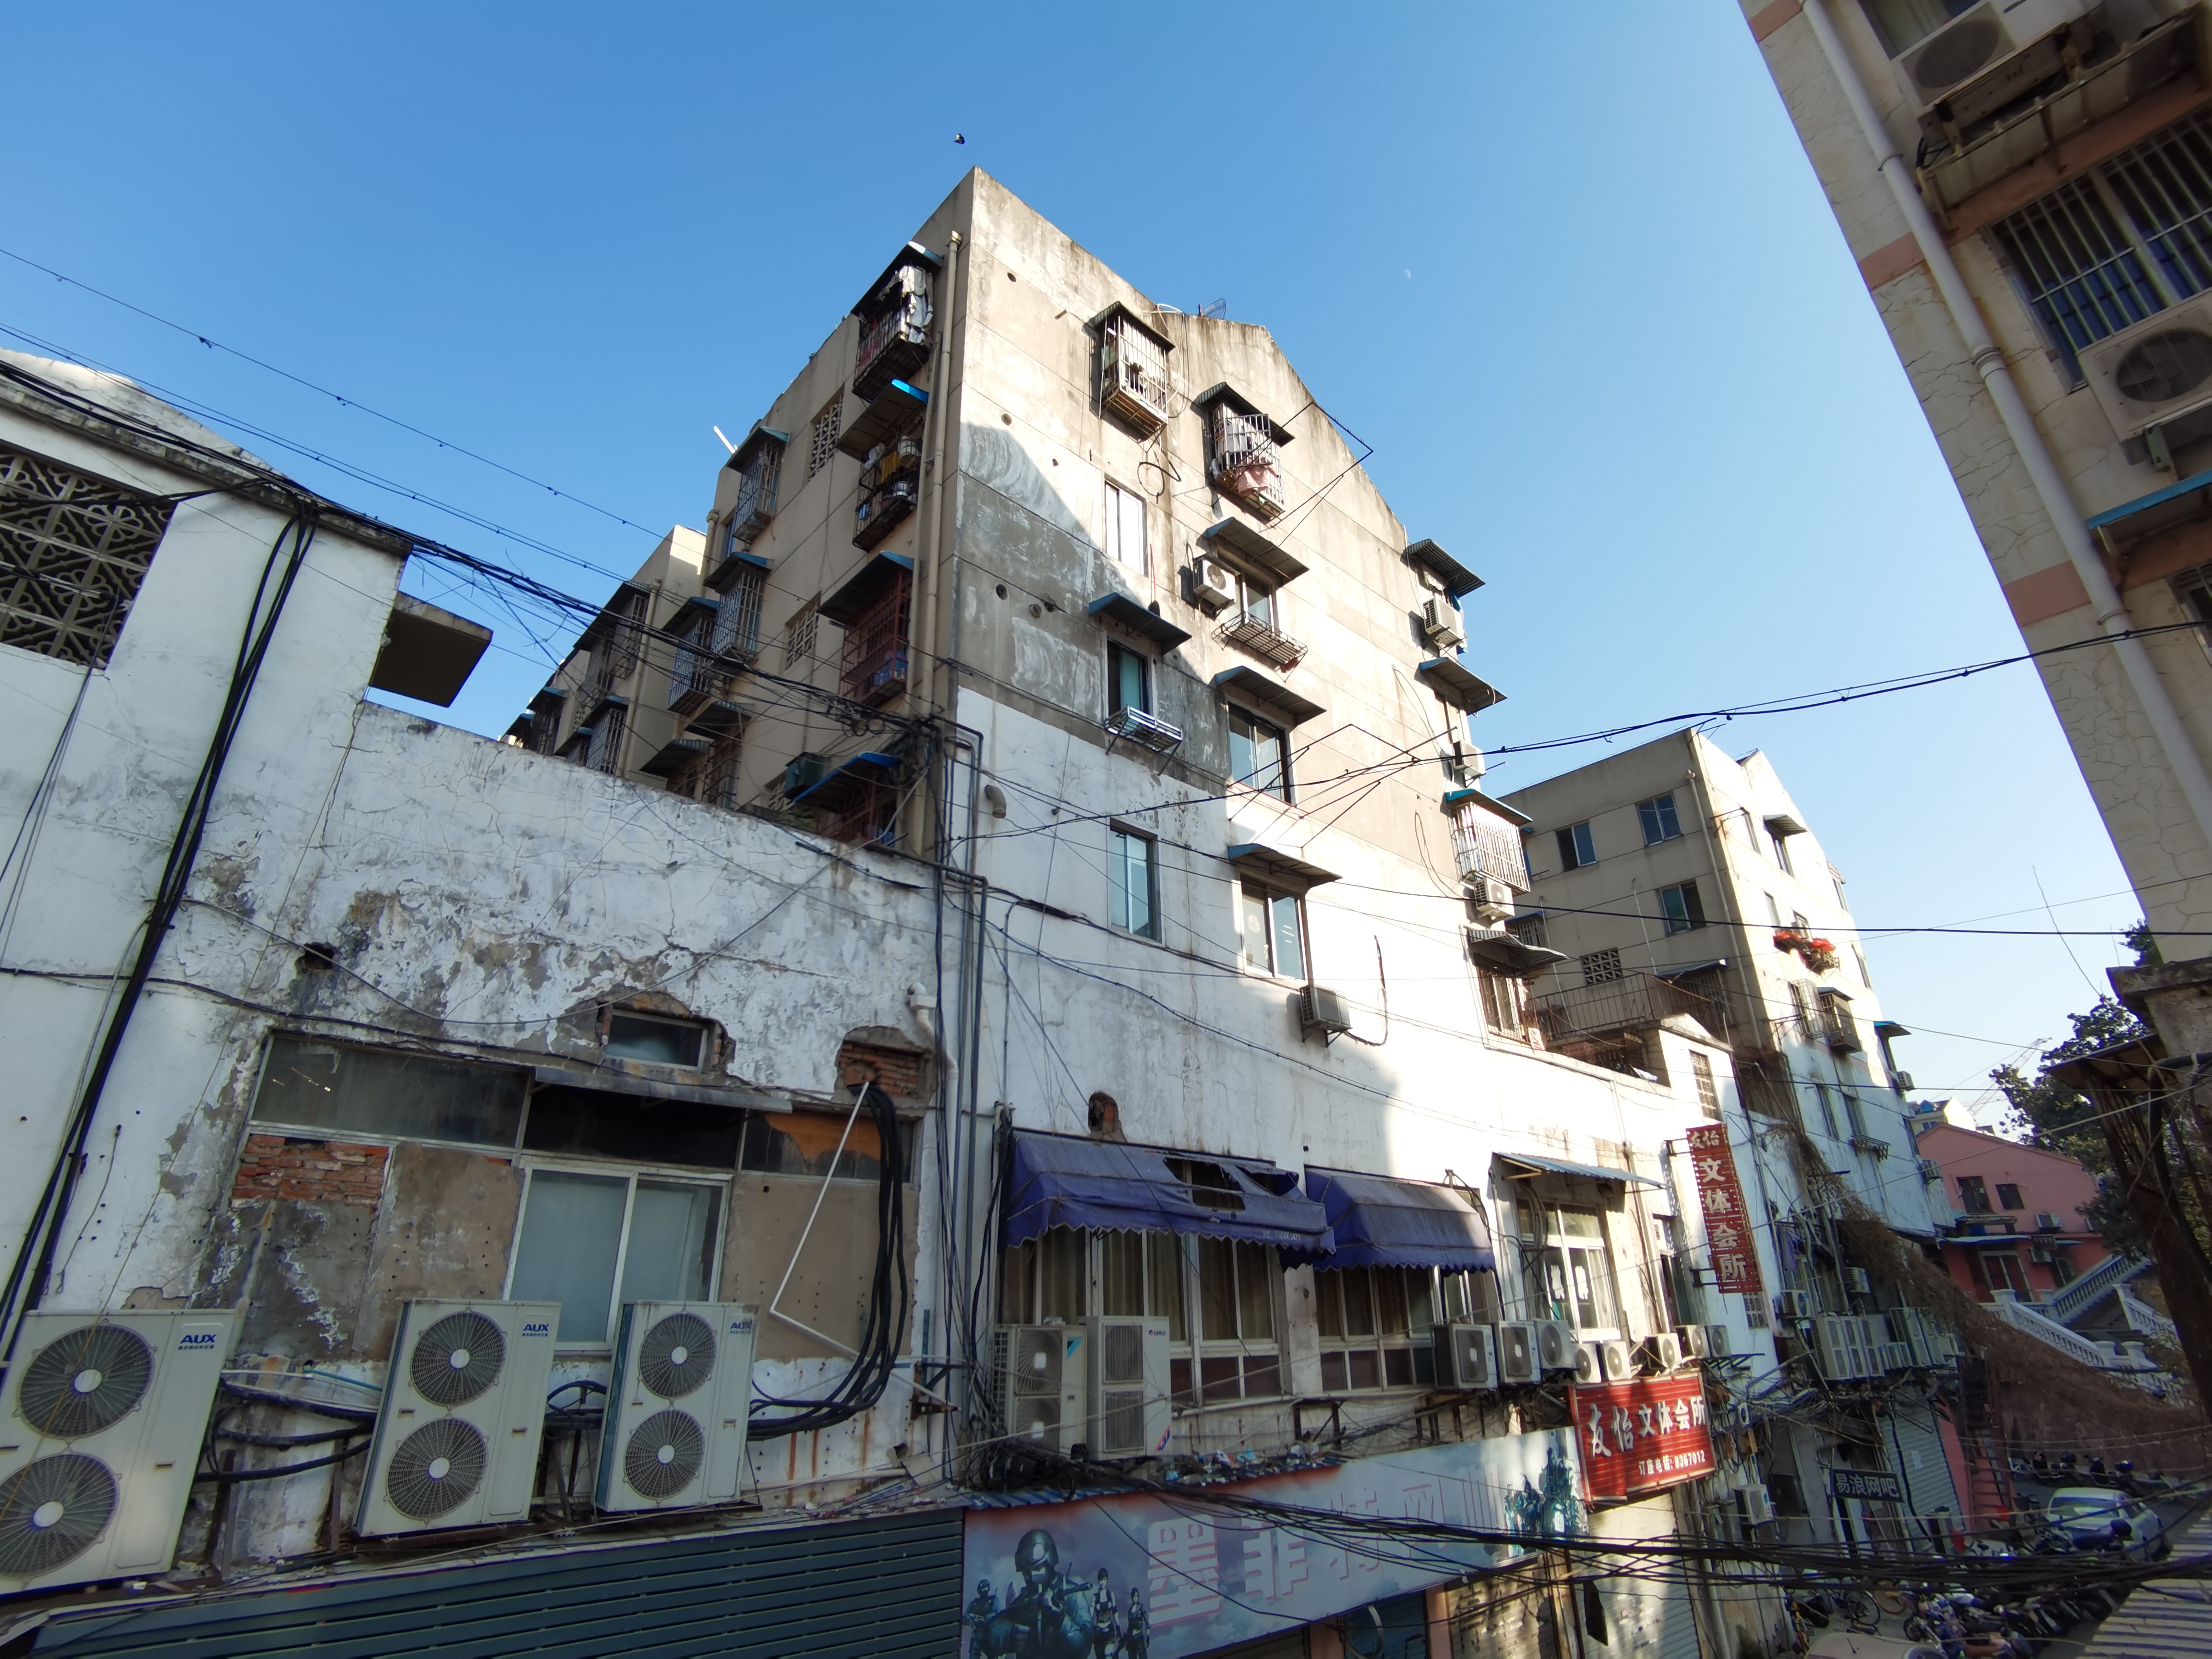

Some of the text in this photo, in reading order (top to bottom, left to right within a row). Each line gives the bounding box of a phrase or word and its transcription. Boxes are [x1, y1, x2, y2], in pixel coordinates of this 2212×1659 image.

[1690, 1130, 1721, 1149] 友怡
[1698, 1157, 1747, 1281] 文体会所
[180, 1334, 216, 1344] AUX
[1835, 1473, 1900, 1498] 易浪网吧
